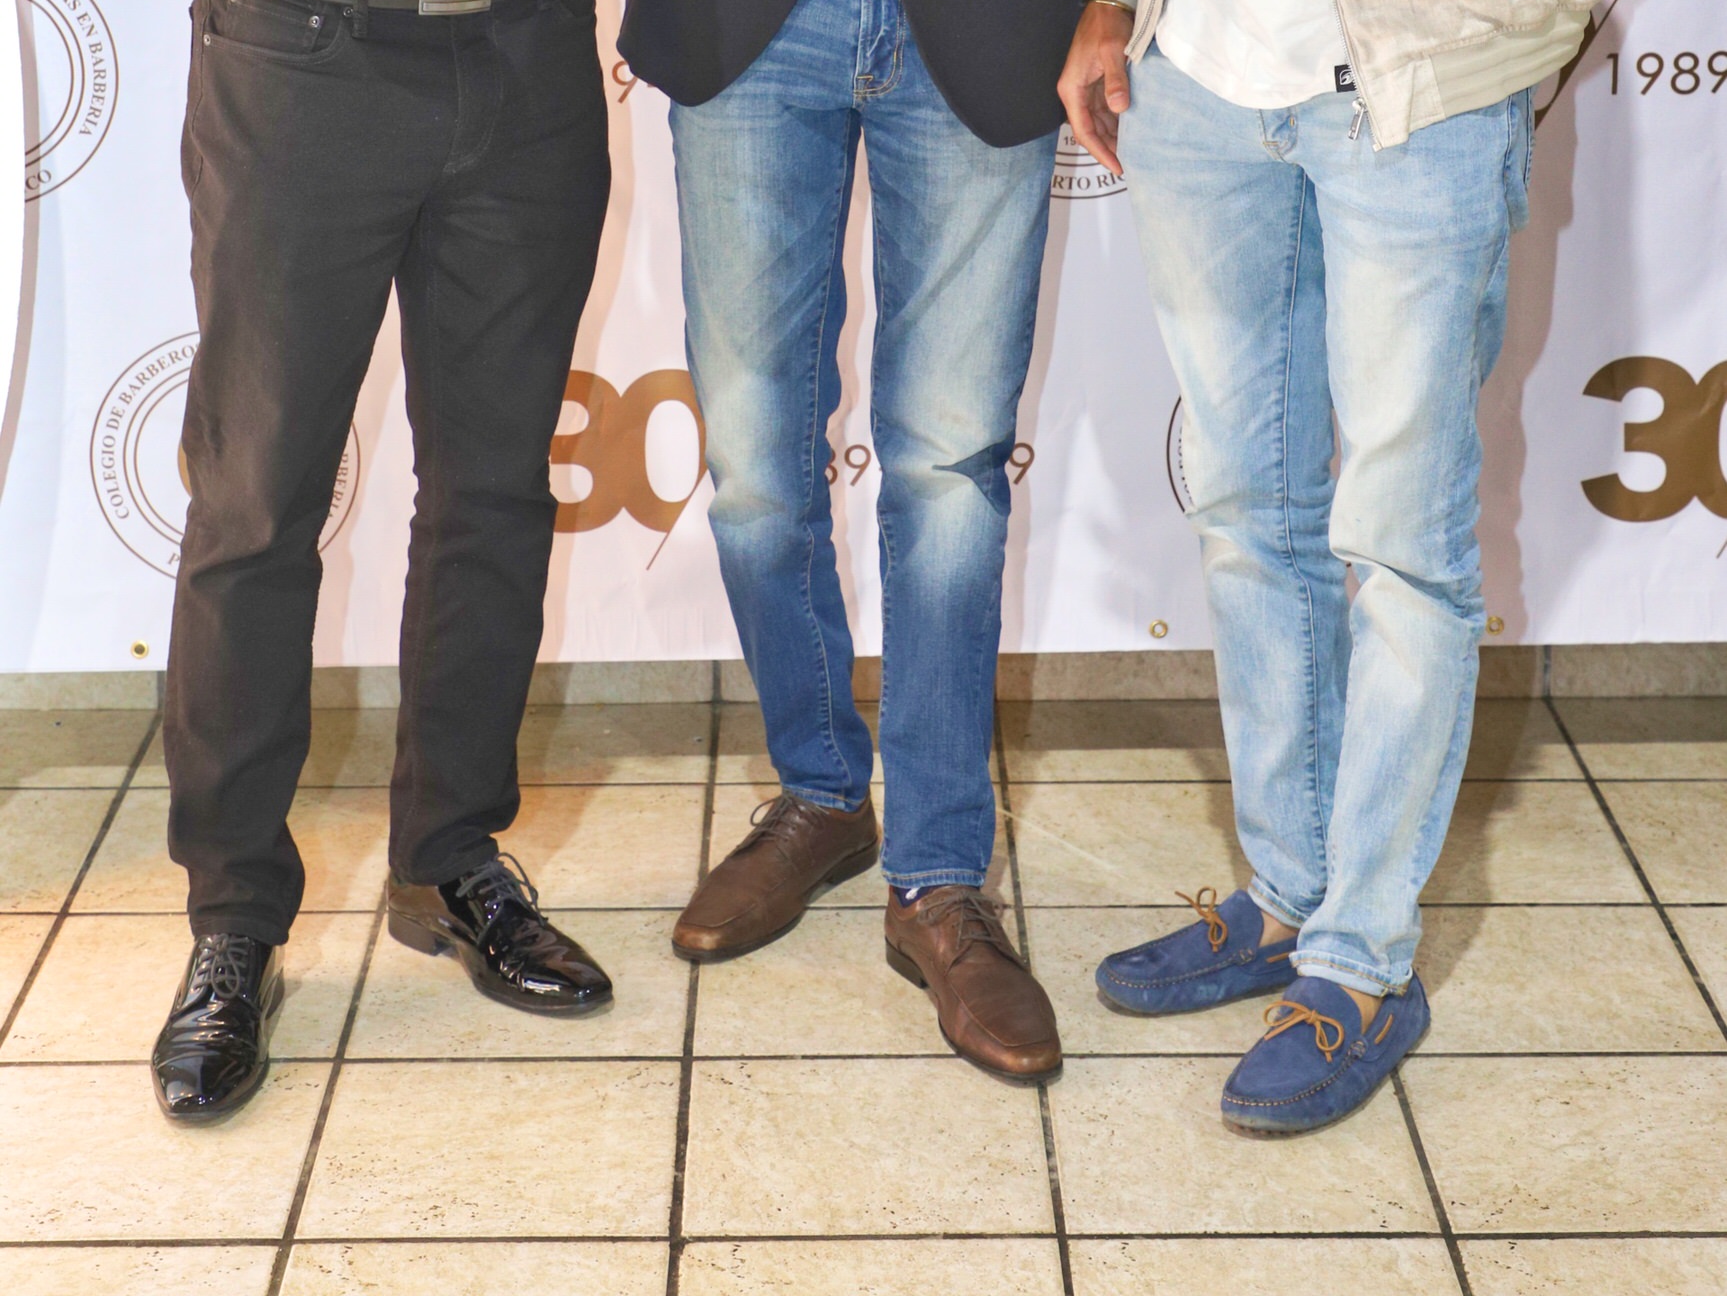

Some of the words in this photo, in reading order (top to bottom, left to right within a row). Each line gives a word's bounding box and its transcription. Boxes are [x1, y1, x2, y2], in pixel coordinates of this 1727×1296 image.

[77, 11, 98, 37] EN
[79, 41, 107, 135] BARBERIA
[118, 343, 199, 405] BARBERO
[106, 406, 125, 431] DE
[101, 435, 130, 521] COLEGIO
